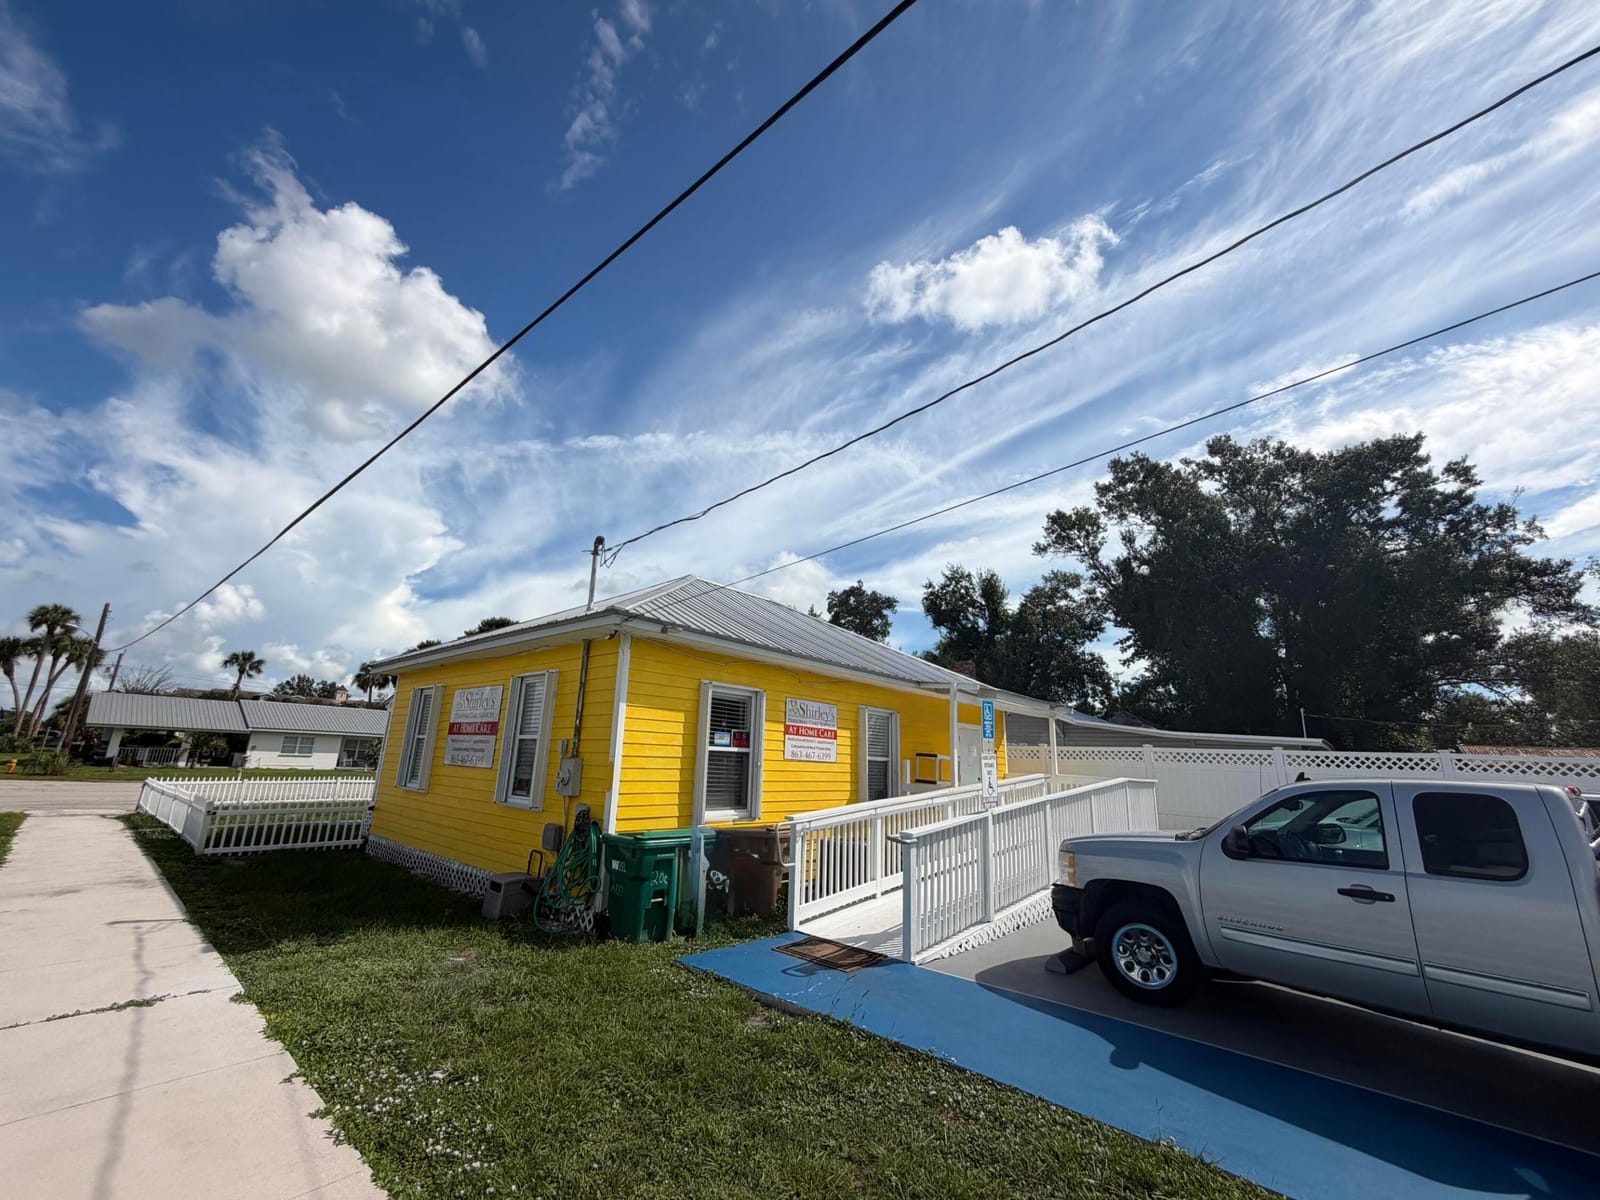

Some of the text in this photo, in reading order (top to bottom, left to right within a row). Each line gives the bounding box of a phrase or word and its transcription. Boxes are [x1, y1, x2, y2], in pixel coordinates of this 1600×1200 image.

[465, 690, 496, 712] Shirley's
[799, 703, 836, 722] Shirley's
[460, 723, 475, 733] HOME
[475, 723, 491, 733] CARE
[788, 726, 835, 739] AT HOME CARE
